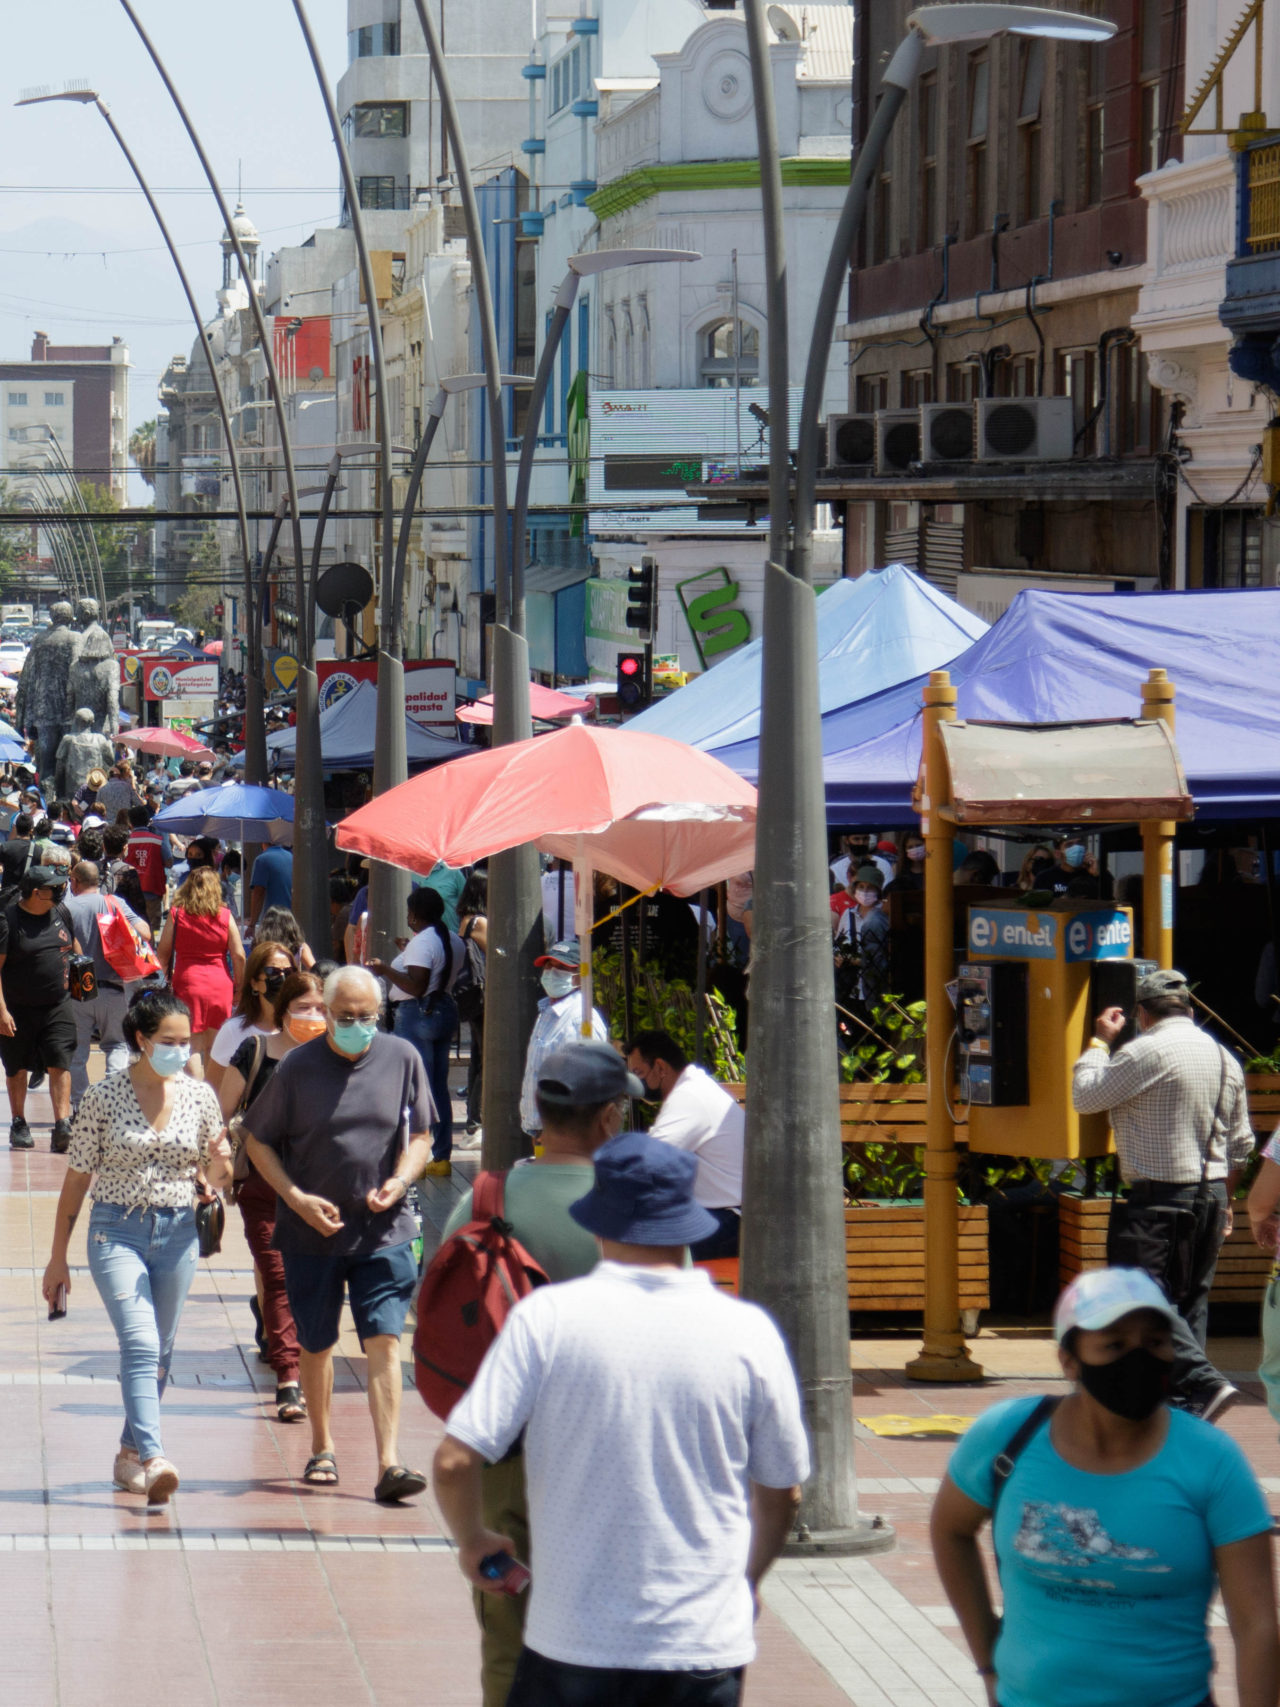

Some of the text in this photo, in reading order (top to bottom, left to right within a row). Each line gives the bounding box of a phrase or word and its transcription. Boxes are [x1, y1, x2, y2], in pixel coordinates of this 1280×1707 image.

[405, 691, 448, 704] palidad
[405, 702, 443, 714] agasta
[1096, 919, 1131, 947] ente
